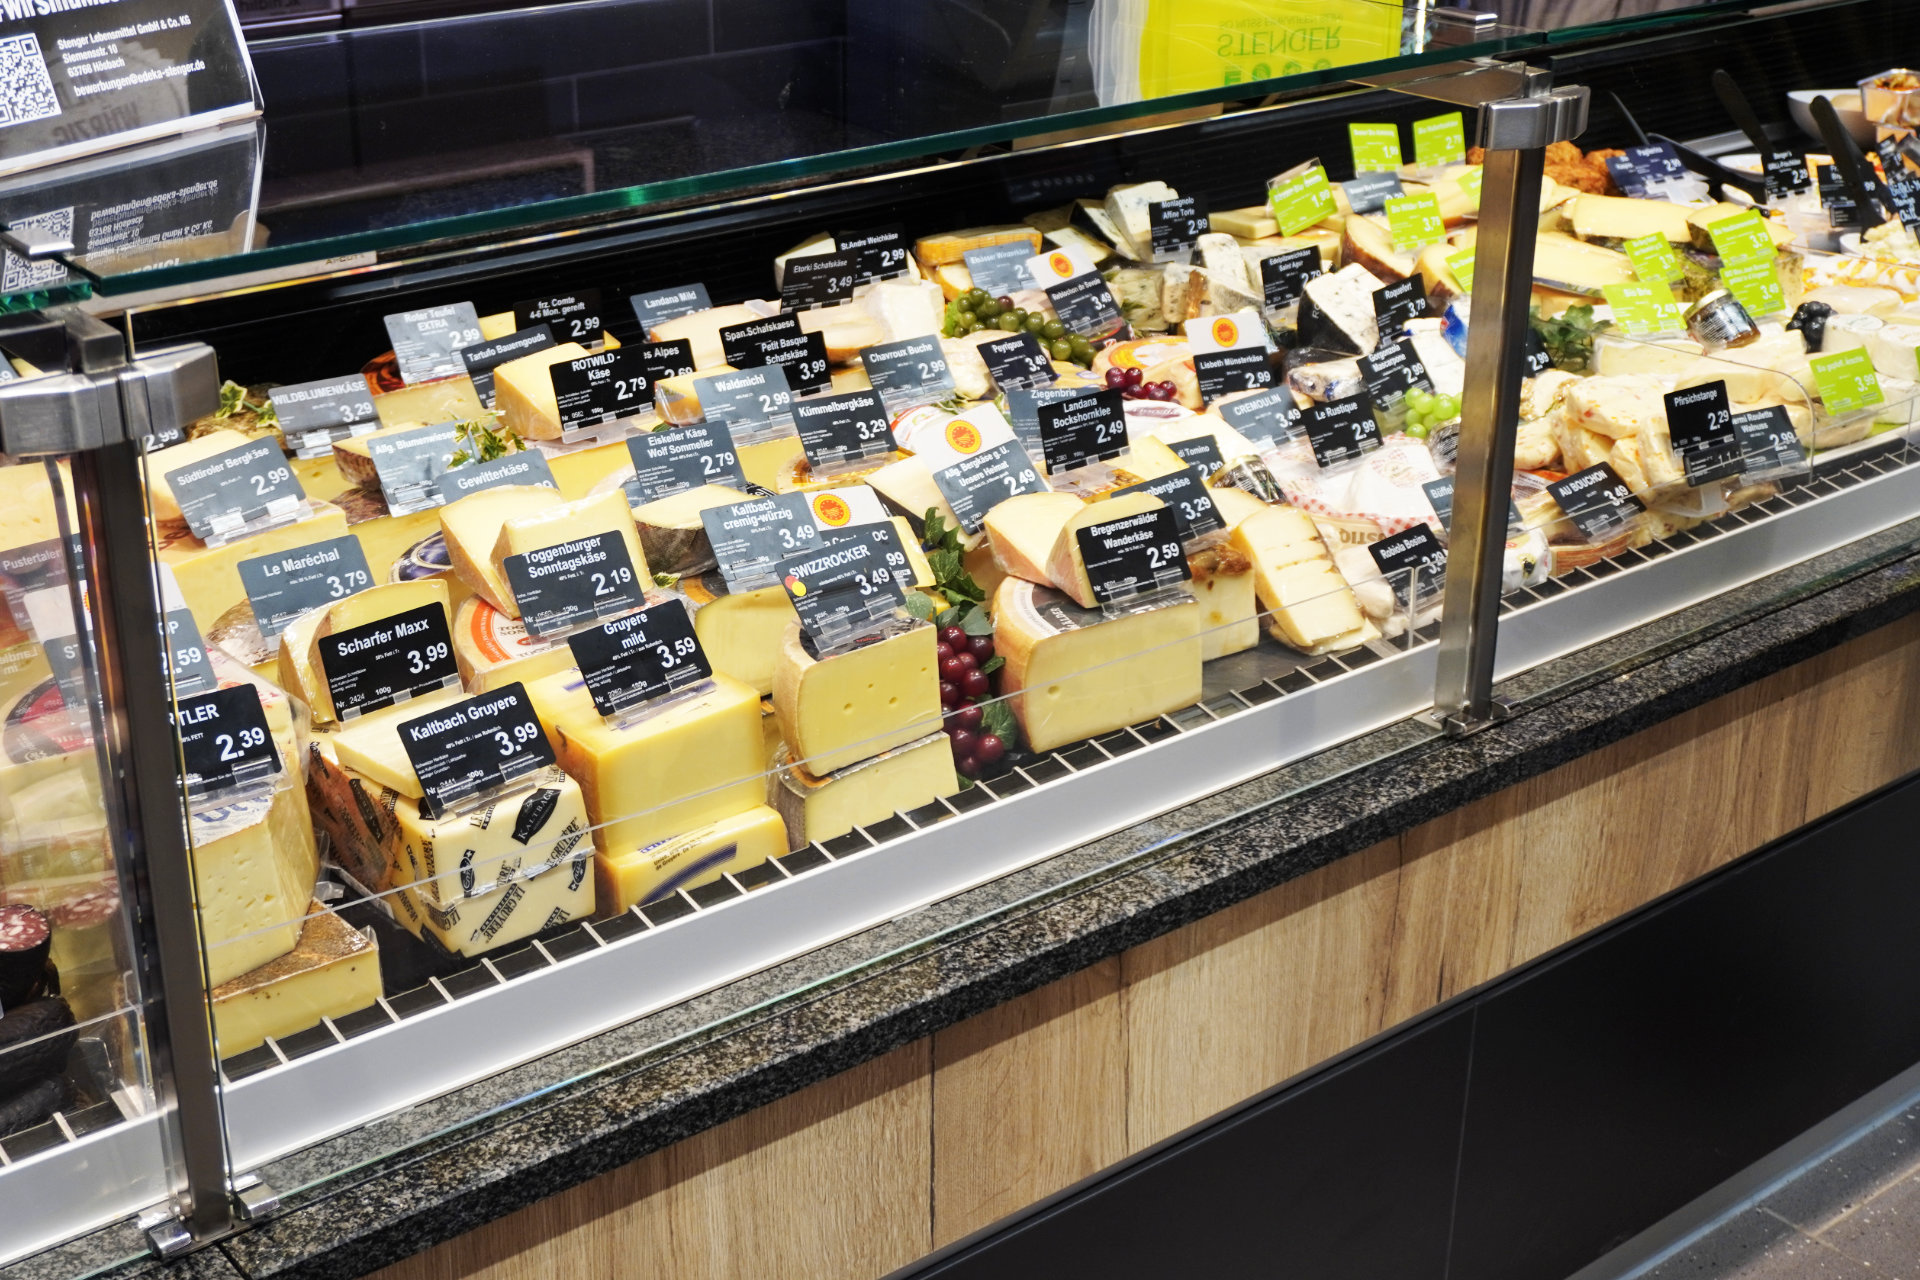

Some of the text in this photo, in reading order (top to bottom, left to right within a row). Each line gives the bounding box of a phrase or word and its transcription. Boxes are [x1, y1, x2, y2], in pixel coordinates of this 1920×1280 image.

[57, 14, 191, 50] Stenger Lebensmittel GmbH & Co. KG
[62, 43, 118, 64] Siemensstr. 10
[67, 58, 125, 78] 63768 Hösbach
[74, 59, 206, 97] bewerbungen@edeka-stenger.de
[1187, 218, 1208, 236] 2.99
[867, 232, 899, 247] Weichkäse
[793, 258, 848, 274] Etorki Schafskäse
[880, 248, 906, 268] 2.99
[827, 275, 853, 294] 3.49
[1384, 281, 1414, 300] Roquefort
[529, 301, 586, 320] 4-6 Mon. gereift
[1090, 292, 1113, 312] 3.49
[1407, 298, 1427, 319] 3.79
[403, 306, 456, 324] Roter Teufel
[416, 319, 449, 333] EXTRA
[448, 327, 481, 349] 2.99
[570, 316, 601, 338] 2.99
[467, 332, 547, 364] Tartufo Bauerngouda
[653, 345, 680, 360] Alpes
[761, 335, 808, 352] Petit Basque
[869, 342, 934, 364] Chavroux Buche
[571, 352, 615, 372] ROTWILD
[765, 349, 808, 365] Schafskäse
[1025, 354, 1048, 374] 3.49
[1200, 354, 1264, 371] Lisbeth Münsterkäse
[1528, 351, 1550, 372] 2.99
[587, 367, 611, 382] Käse
[800, 359, 827, 380] 3.99
[918, 360, 946, 380] 2.99
[1245, 370, 1272, 390] 2.99
[1402, 362, 1425, 384] 2.99
[271, 380, 367, 406] WILDBLUMENKÄSE
[615, 376, 647, 401] 2.79
[715, 373, 766, 393] Waldmichl
[1854, 374, 1876, 394] 3.99
[759, 391, 791, 414] 2.99
[1030, 388, 1077, 401] Ziegenbrie
[1063, 397, 1099, 413] Landana
[1233, 393, 1282, 417] CREMOULIN
[1674, 388, 1718, 408] Pfirsichstange
[338, 401, 374, 423] 3.29
[798, 396, 875, 418] Kümmelbergkäse
[1053, 407, 1112, 429] Bockshornklee
[1315, 400, 1359, 421] Le Rustique
[1275, 408, 1302, 429] 3.49
[1707, 410, 1731, 432] 2.29
[145, 428, 180, 452] 2.99
[647, 426, 708, 448] Eiskeller Käse
[856, 419, 888, 441] 3.29
[1095, 419, 1125, 444] 2.49
[1351, 419, 1377, 442] 2.99
[1769, 430, 1797, 452] 2.99
[375, 442, 396, 456] Allg.
[647, 438, 714, 459] Wolf Sommelier
[176, 446, 271, 487] Südtiroler Bergkäse
[699, 451, 735, 476] 2.79
[944, 464, 962, 480] Allg.
[961, 452, 994, 474] Bergkäse
[959, 461, 1010, 488] Unsere Heimat
[249, 466, 291, 497] 2.99
[457, 462, 530, 490] Gewitterkäse
[1003, 468, 1037, 497] 2.49
[1558, 469, 1608, 498] AU BOUCHON
[1603, 485, 1630, 508] 3.49
[723, 508, 793, 530] cremig-würzig
[731, 499, 777, 517] Kaltbach
[1180, 496, 1212, 520] 3.29
[1090, 512, 1158, 537] Bregenzerwälder
[778, 524, 815, 549] 3.49
[1103, 529, 1154, 550] Wanderkäse
[1379, 534, 1428, 560] Robiola Bosina
[2, 549, 62, 572] Pustertaler
[522, 536, 602, 565] Toggenburger
[788, 543, 871, 580] SWIZZROCKER
[1146, 542, 1180, 569] 2.59
[262, 548, 341, 578] Le Maréchal
[527, 550, 608, 580] Sonntagskäse
[325, 569, 369, 598] 3.79
[590, 566, 633, 597] 2.19
[854, 567, 891, 600] 3.49
[394, 618, 431, 640] Maxx
[603, 612, 648, 636] Gruyere
[337, 629, 393, 657] Scharfer
[620, 630, 648, 650] mild
[406, 641, 449, 675] 3.99
[656, 636, 703, 670] 3.59
[410, 694, 519, 742] Kaltbach Gruyere
[215, 726, 266, 763] 2.39
[494, 721, 540, 757] 3.99
